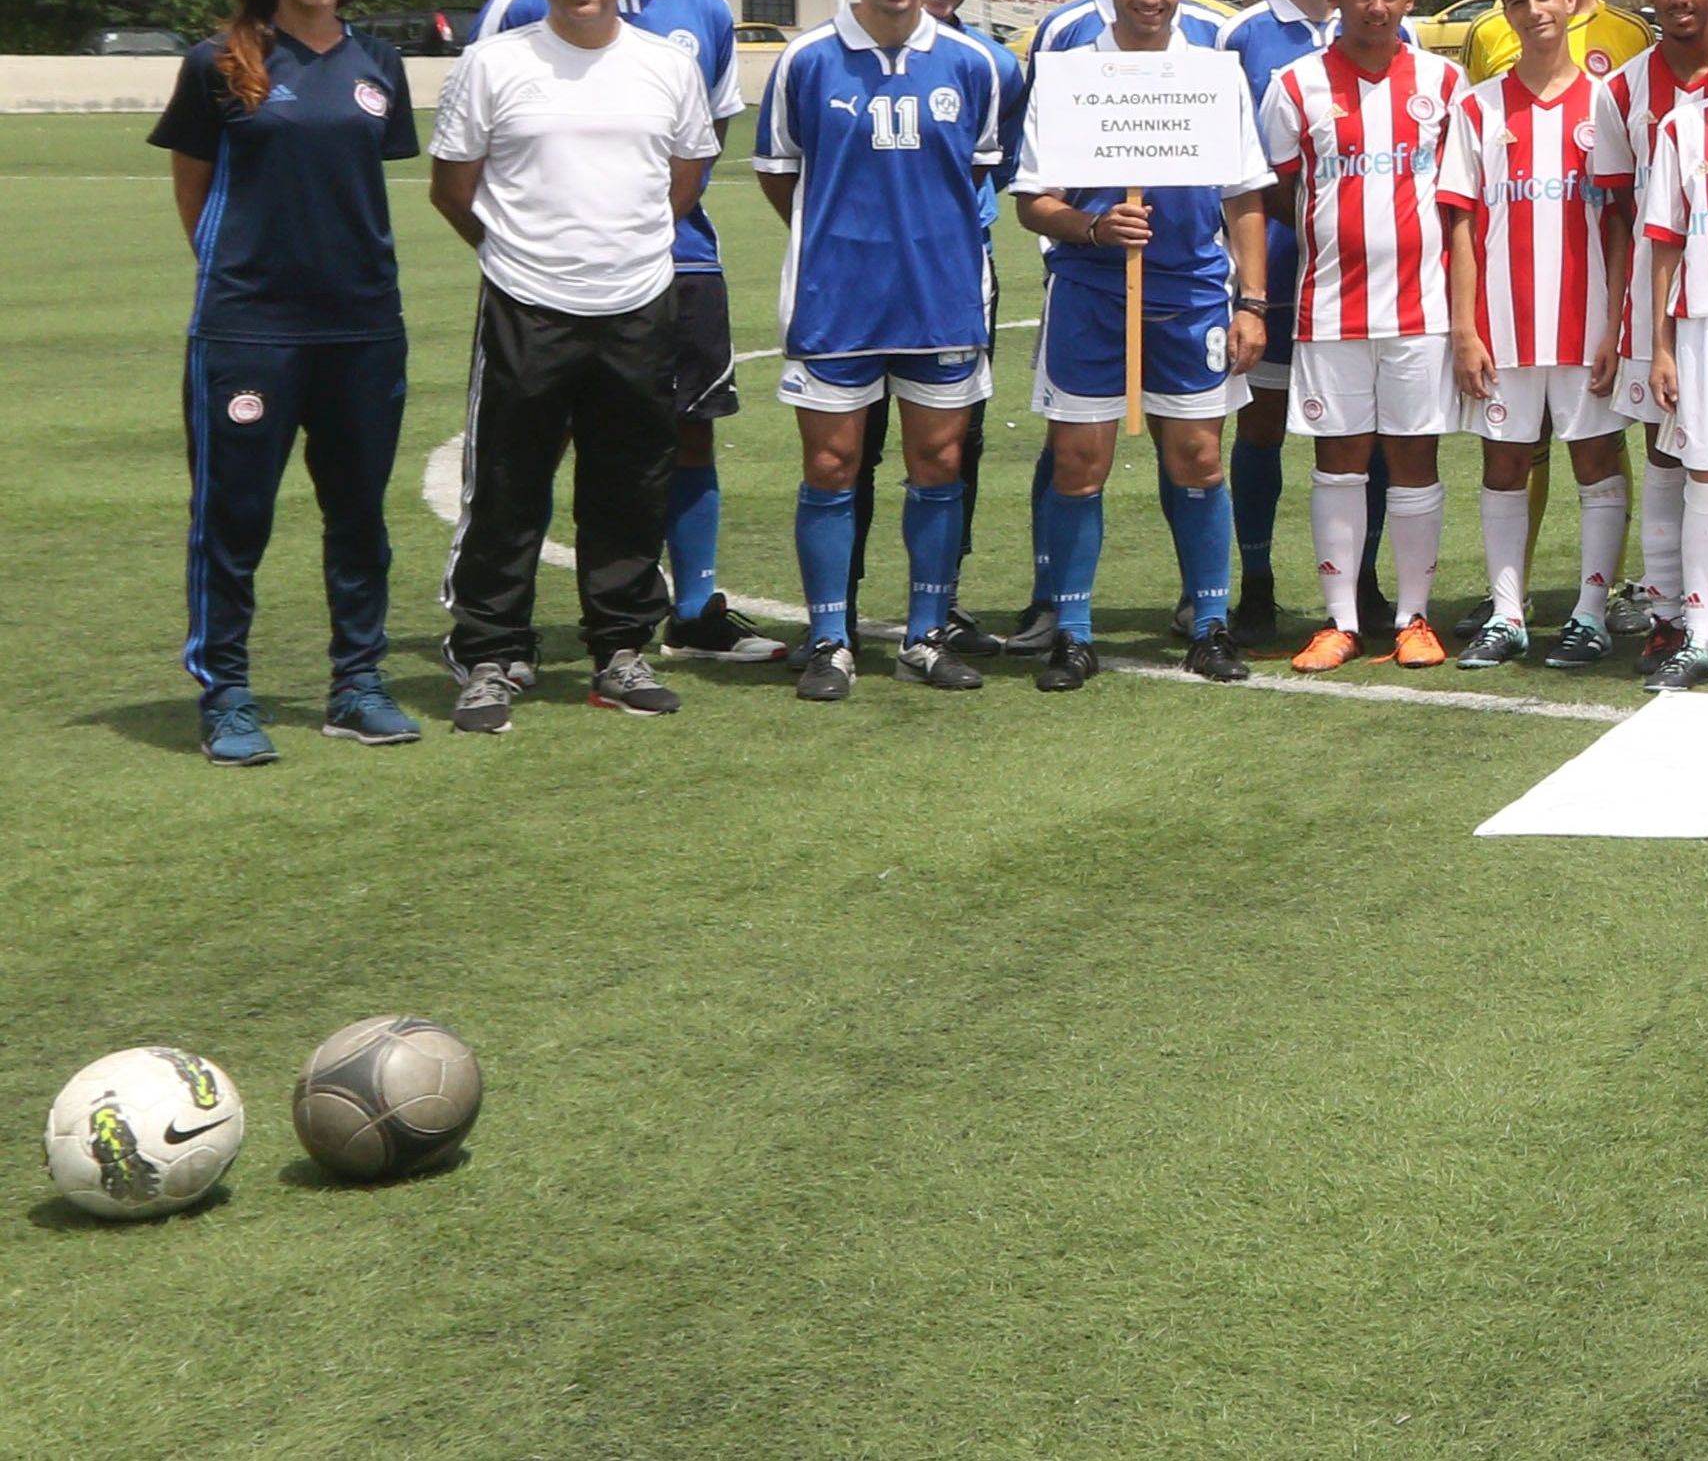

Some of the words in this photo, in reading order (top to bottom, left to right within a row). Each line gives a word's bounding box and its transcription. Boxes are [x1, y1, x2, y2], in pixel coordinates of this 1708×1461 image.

[867, 96, 920, 149] 11
[1100, 118, 1192, 132] ΕΛΛΗΝΙΚΗΣ
[1094, 144, 1199, 158] ΑΣΤΥΝΟΜΙΑΣ
[1483, 169, 1578, 207] unicef
